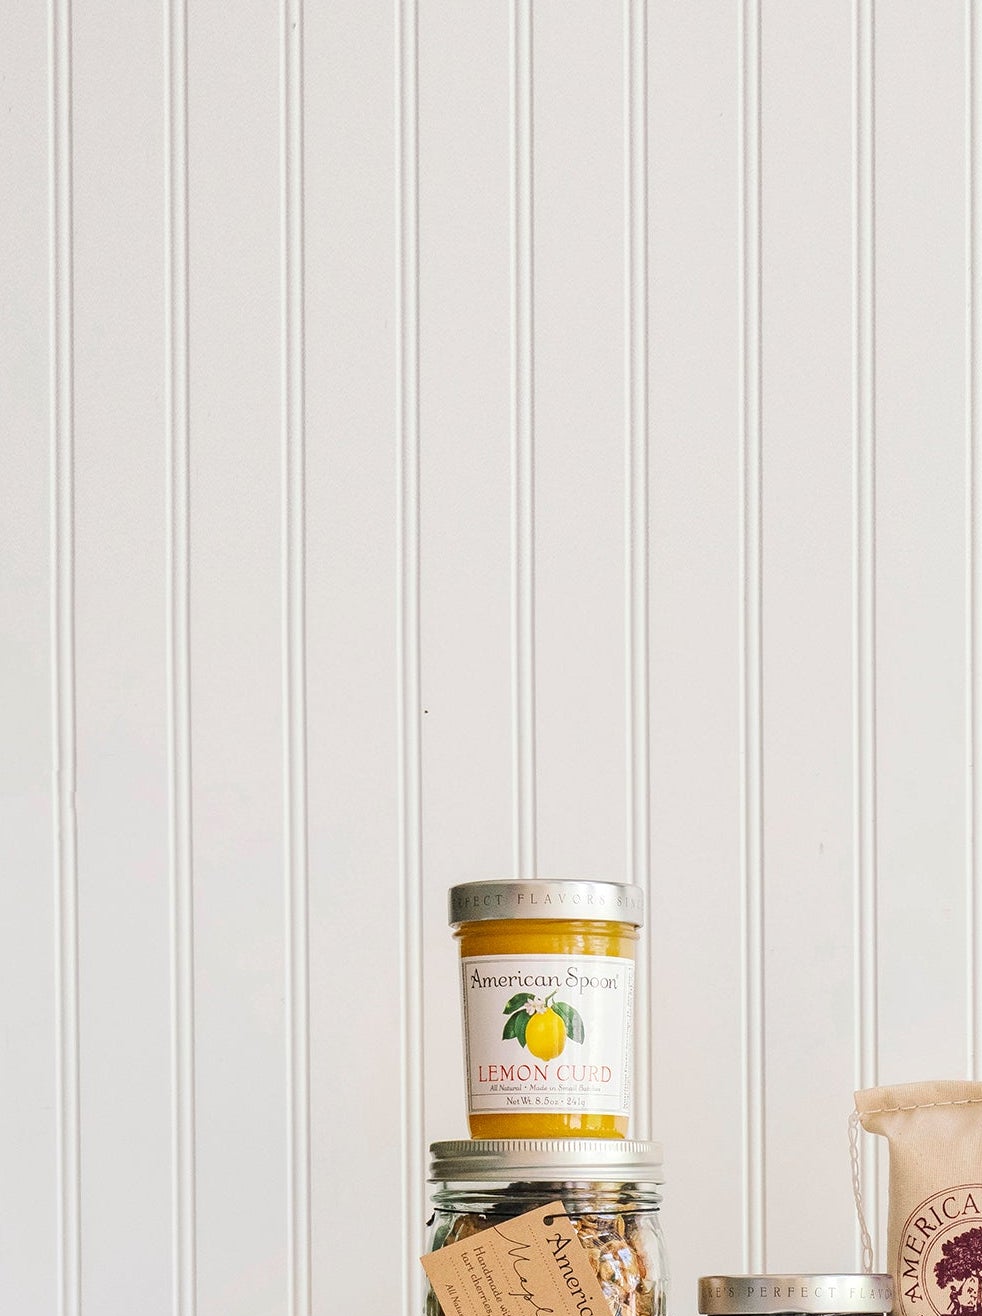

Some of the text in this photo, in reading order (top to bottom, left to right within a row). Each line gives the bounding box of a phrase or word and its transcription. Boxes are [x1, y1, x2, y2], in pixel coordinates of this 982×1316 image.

[471, 968, 562, 989] American
[478, 1064, 612, 1083] LEMON CURD
[461, 1252, 474, 1272] tart
[473, 1246, 503, 1303] Handmade
[747, 1286, 836, 1299] PERFECT
